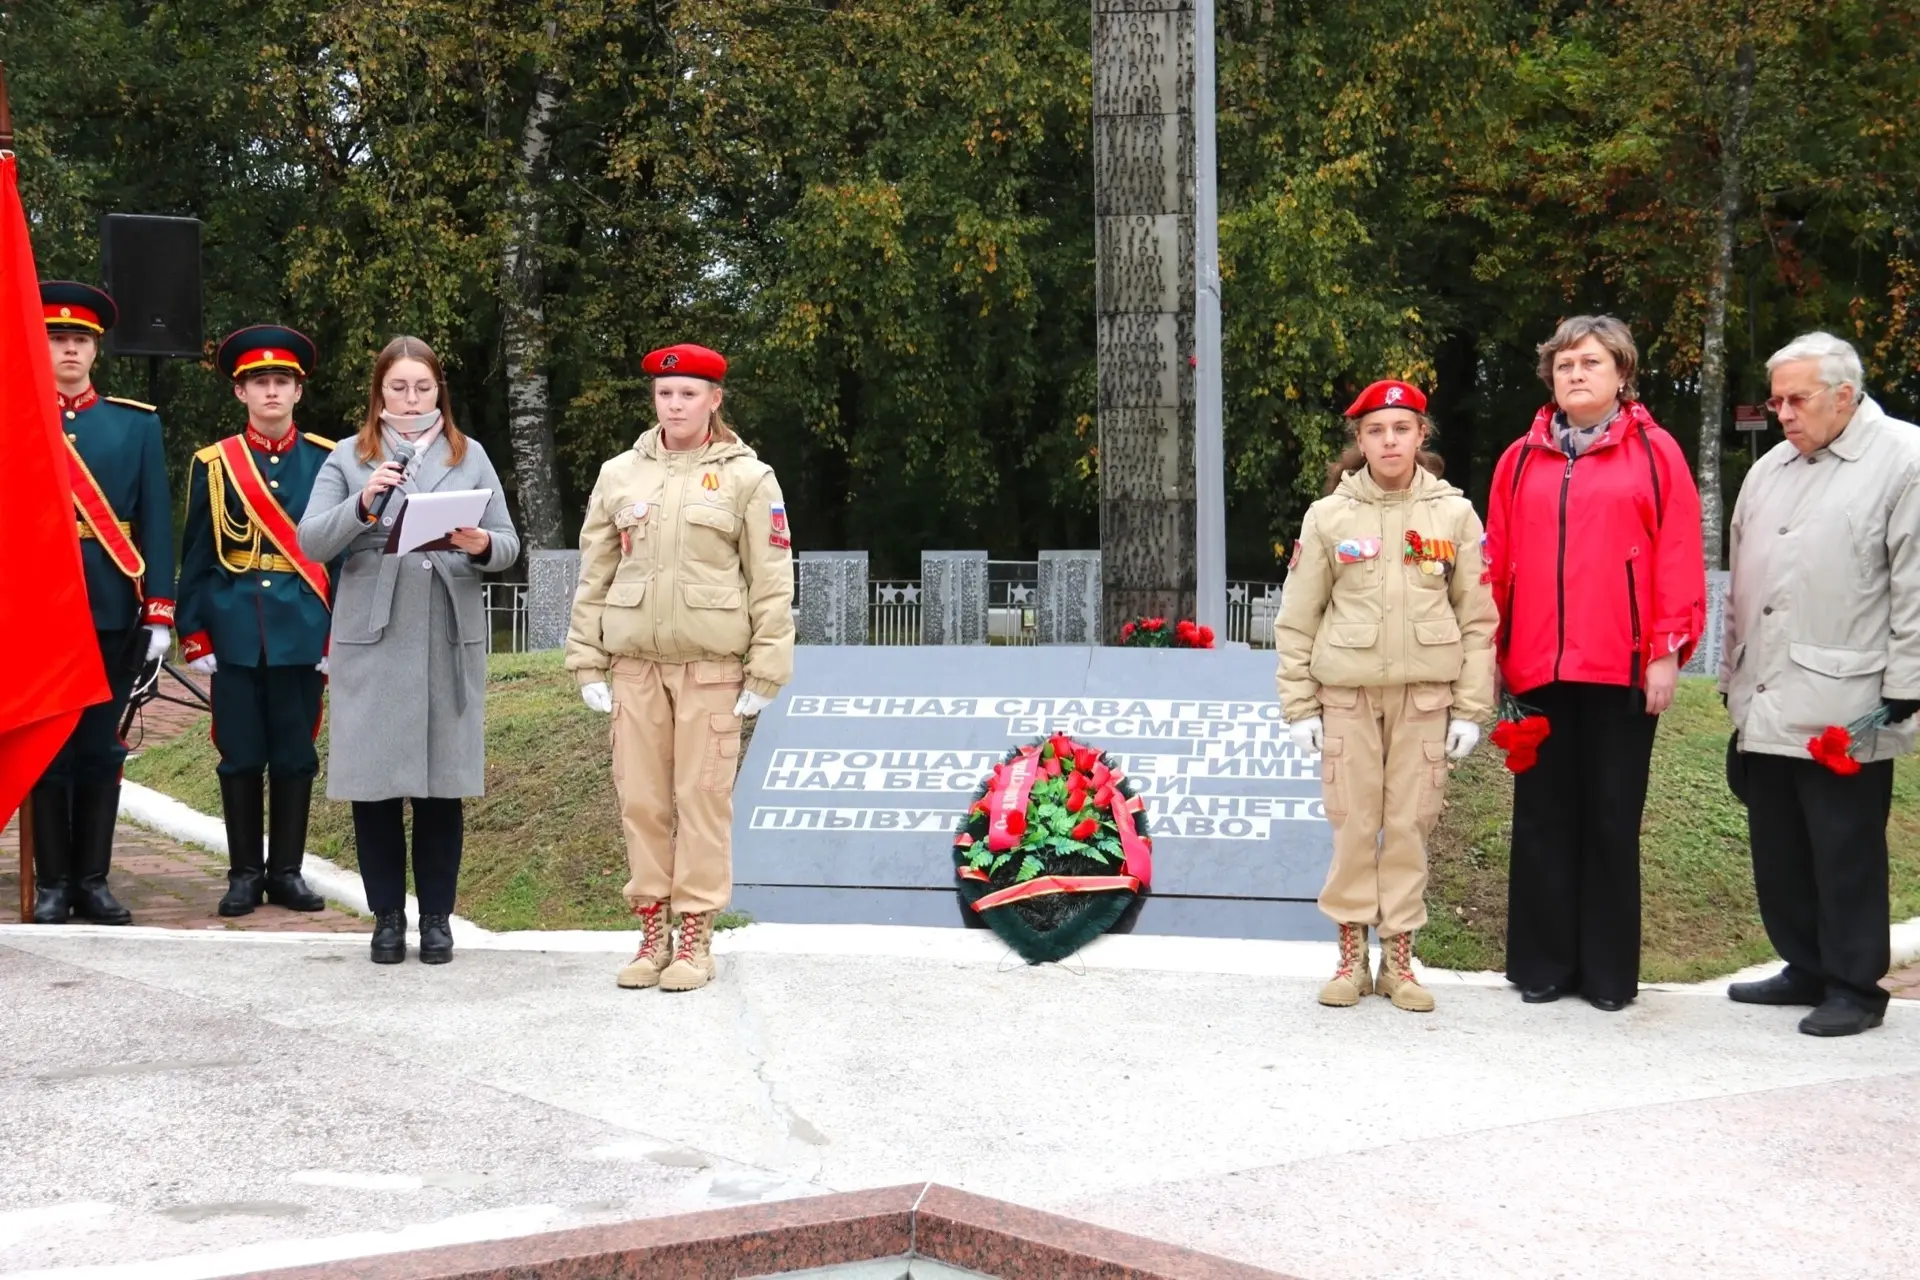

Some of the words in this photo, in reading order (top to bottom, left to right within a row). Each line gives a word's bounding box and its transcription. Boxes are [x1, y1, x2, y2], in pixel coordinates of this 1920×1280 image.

[790, 698, 977, 716] ВЕЧНАЯ
[994, 699, 1153, 718] СЛАВА
[1170, 701, 1282, 721] ГЕРО
[1010, 717, 1291, 740] БЕССМЕРТН
[1196, 740, 1311, 759] ГИМ
[766, 770, 866, 790] НАД
[752, 808, 964, 830] ПЛЫВУТ
